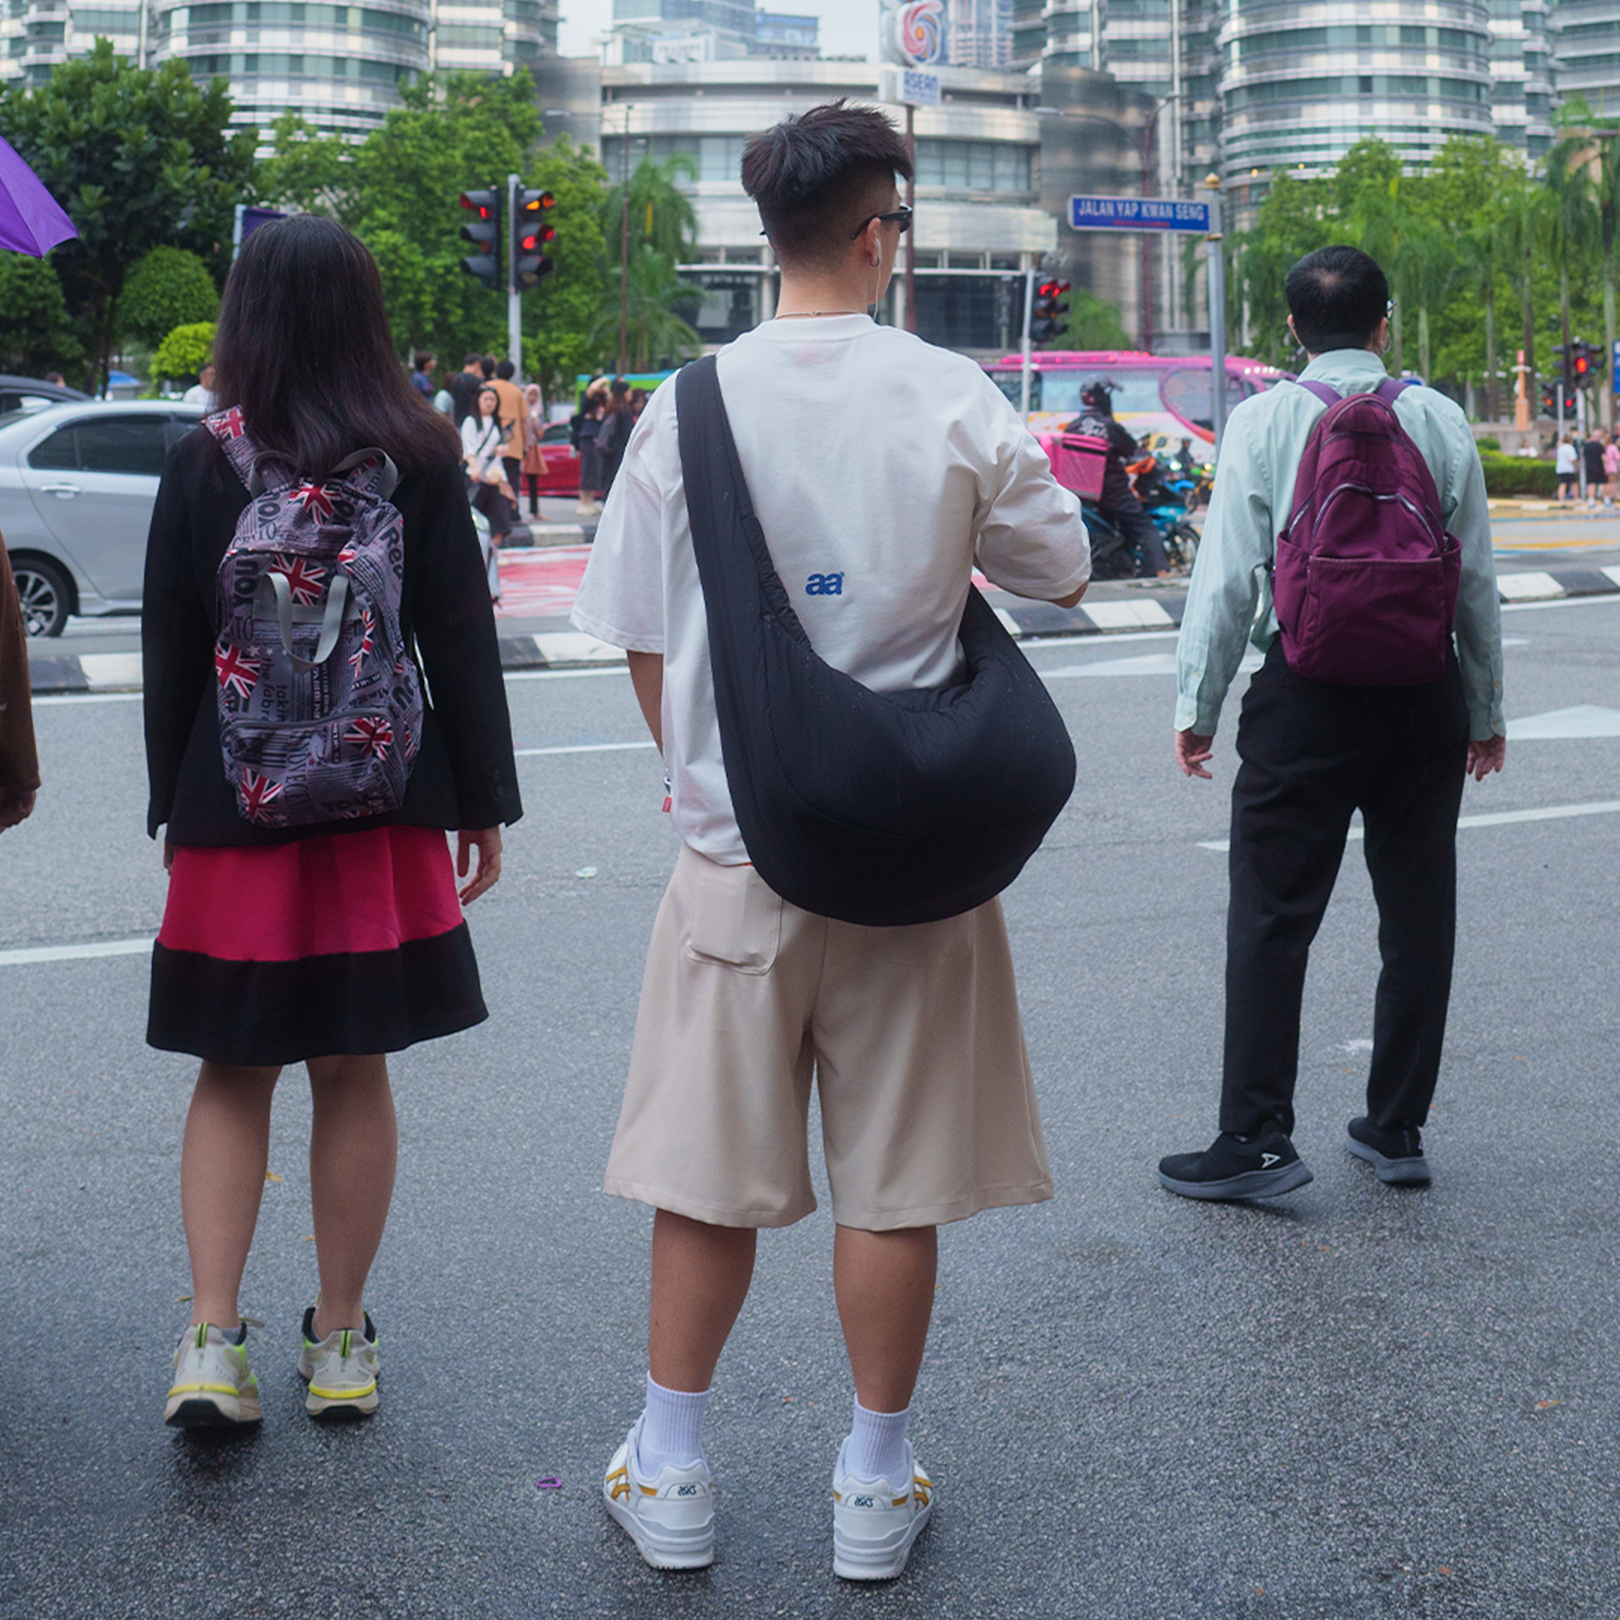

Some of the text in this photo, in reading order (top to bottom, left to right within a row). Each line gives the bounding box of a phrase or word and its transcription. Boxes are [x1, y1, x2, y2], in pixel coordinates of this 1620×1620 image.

[1078, 200, 1204, 221] JALAN YAP KWAN SENG
